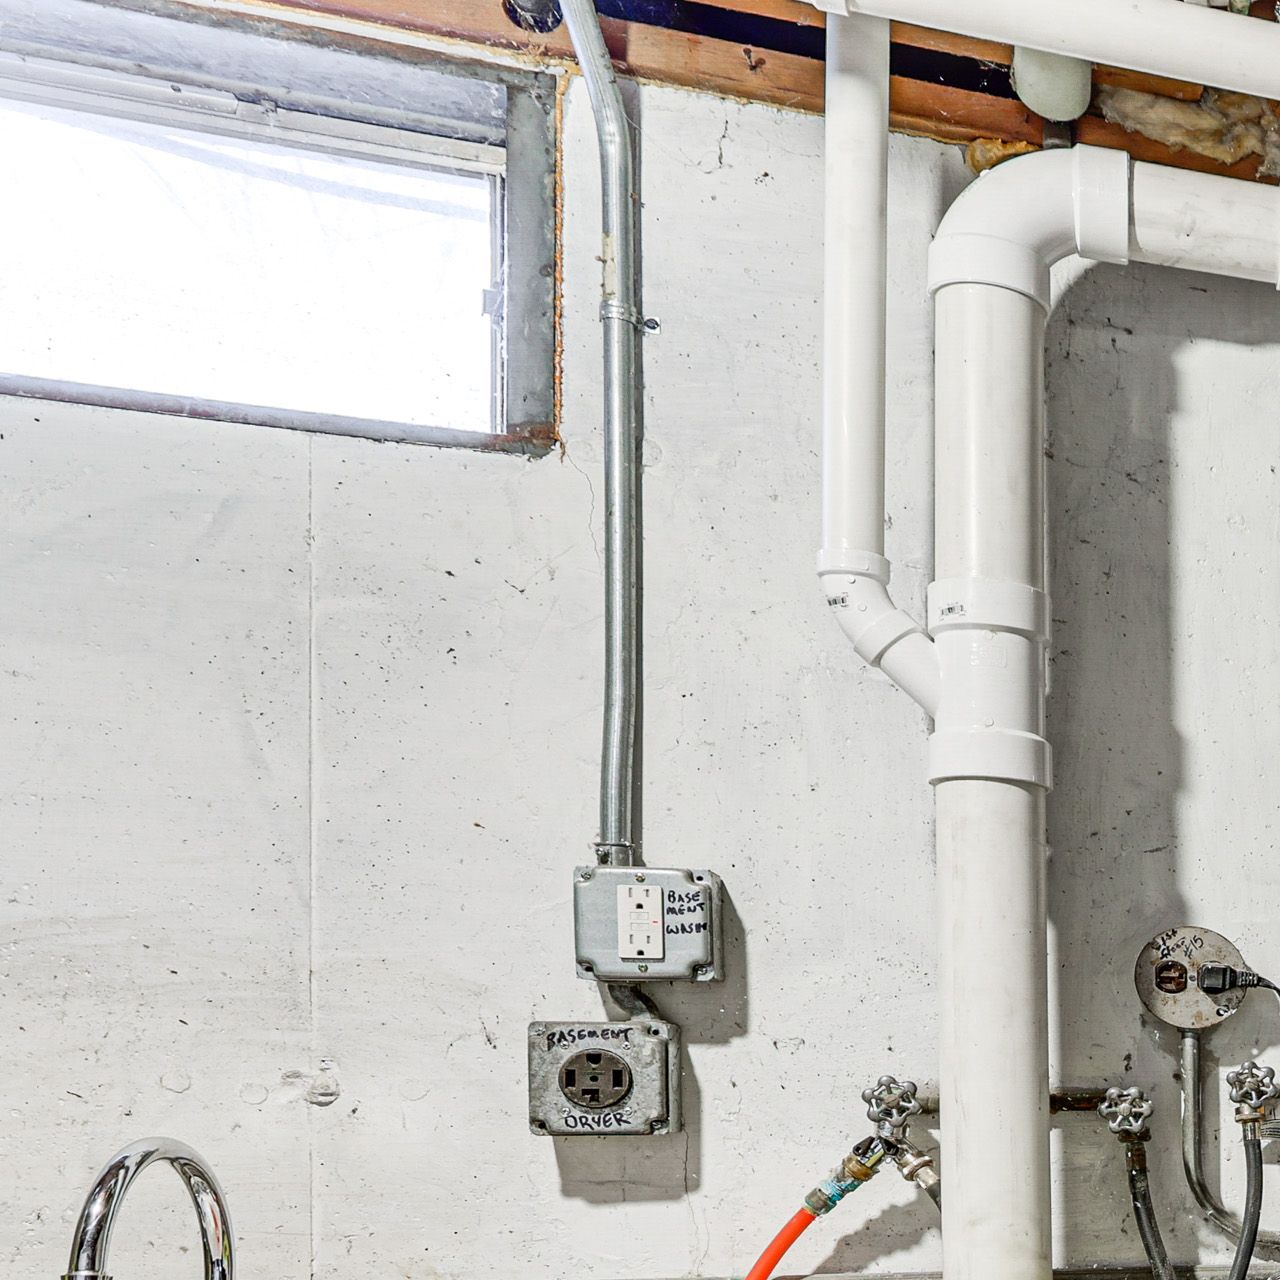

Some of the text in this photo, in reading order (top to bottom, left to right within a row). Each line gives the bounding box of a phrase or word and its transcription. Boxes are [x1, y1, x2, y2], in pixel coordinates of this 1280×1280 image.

[667, 890, 701, 903] BASE
[666, 903, 706, 915] MENT
[546, 1027, 634, 1051] BASEMENT
[564, 1112, 631, 1130] DRYER
